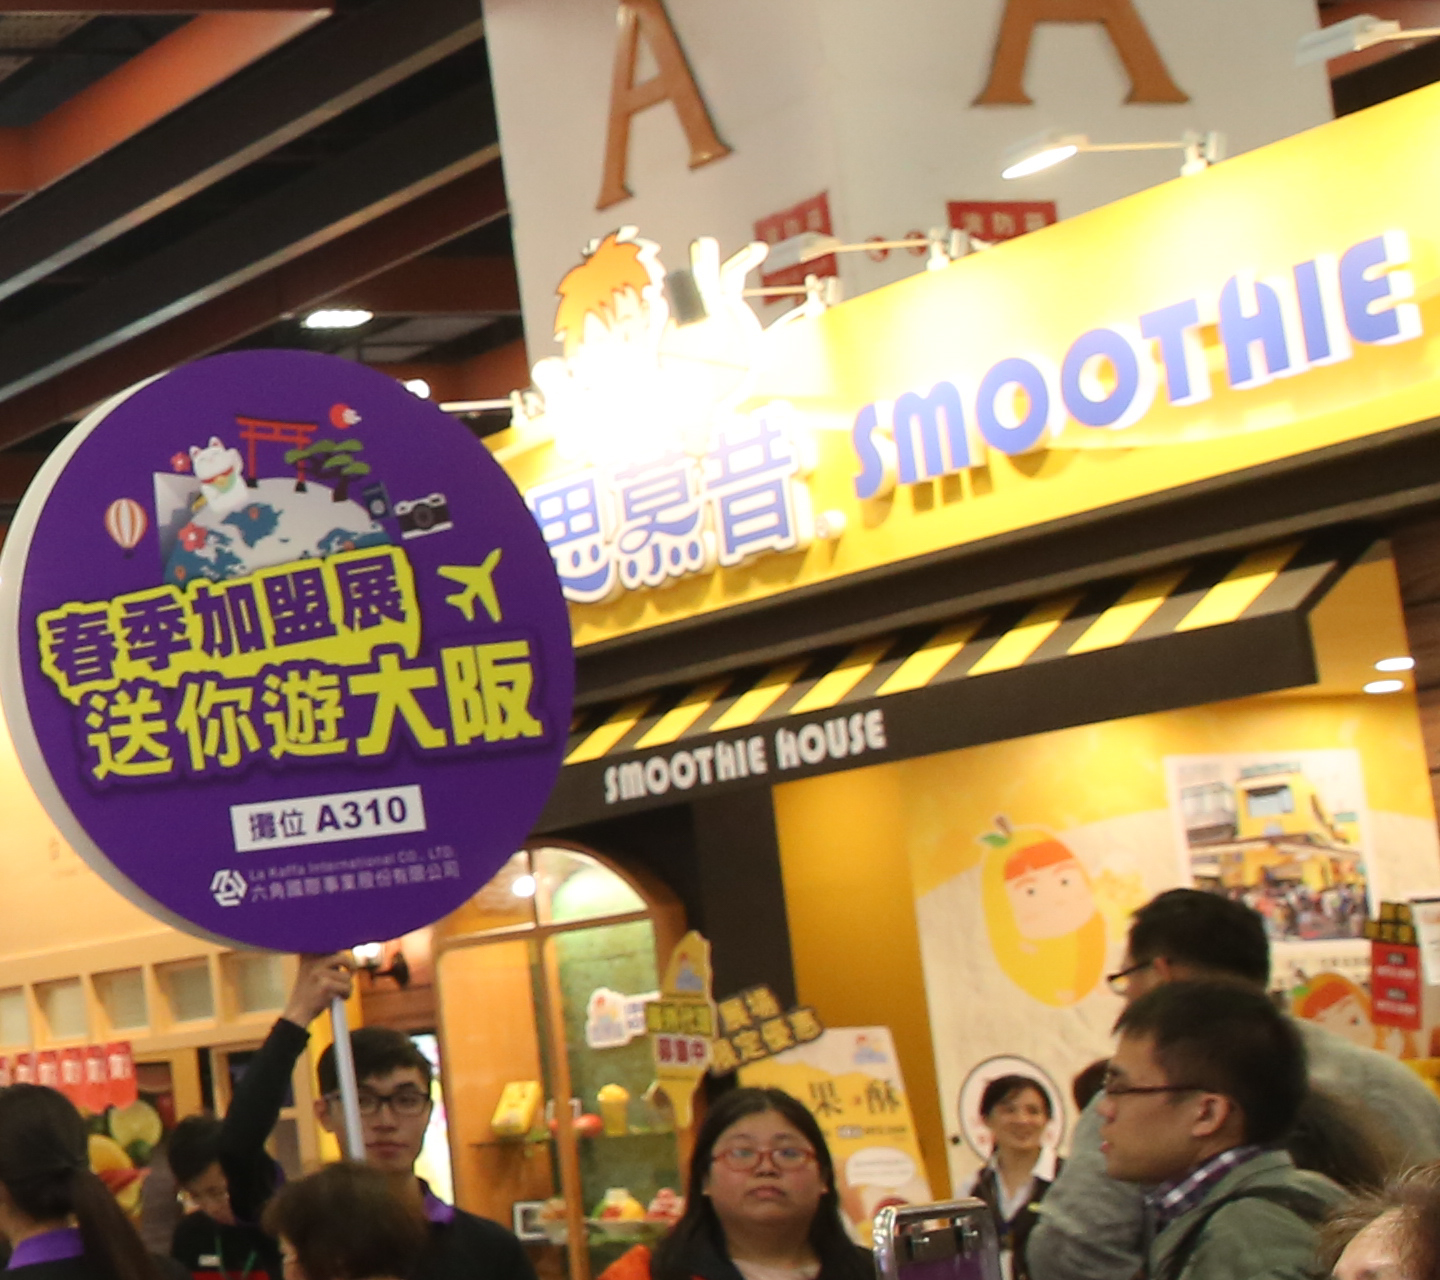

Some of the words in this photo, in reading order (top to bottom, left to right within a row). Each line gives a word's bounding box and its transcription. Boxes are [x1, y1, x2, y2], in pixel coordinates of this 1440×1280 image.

[851, 232, 1418, 502] SMOOTHIE
[532, 417, 810, 600] 思慕昔
[46, 558, 412, 688] 春季加盟展
[85, 639, 542, 781] 送你遊大阪
[604, 740, 768, 805] SMOOTHIE
[777, 709, 888, 769] HOUSE
[249, 808, 307, 842] 攤位
[317, 795, 408, 833] A310
